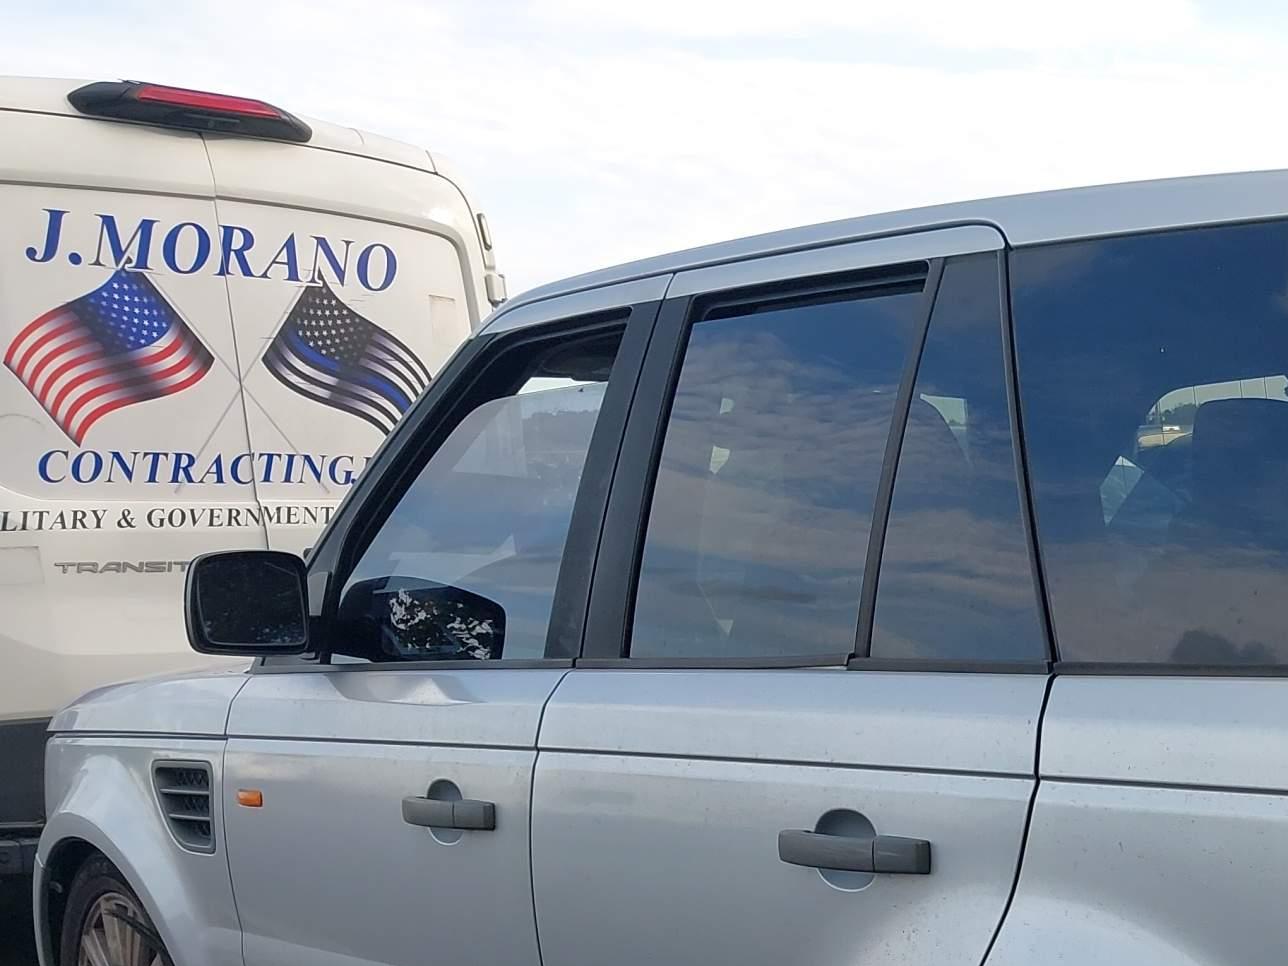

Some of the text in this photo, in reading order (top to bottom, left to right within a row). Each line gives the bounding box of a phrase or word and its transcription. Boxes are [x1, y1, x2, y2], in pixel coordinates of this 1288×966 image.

[25, 208, 398, 292] J.MORANO
[117, 508, 136, 529] &
[54, 561, 190, 574] TRANSIT
